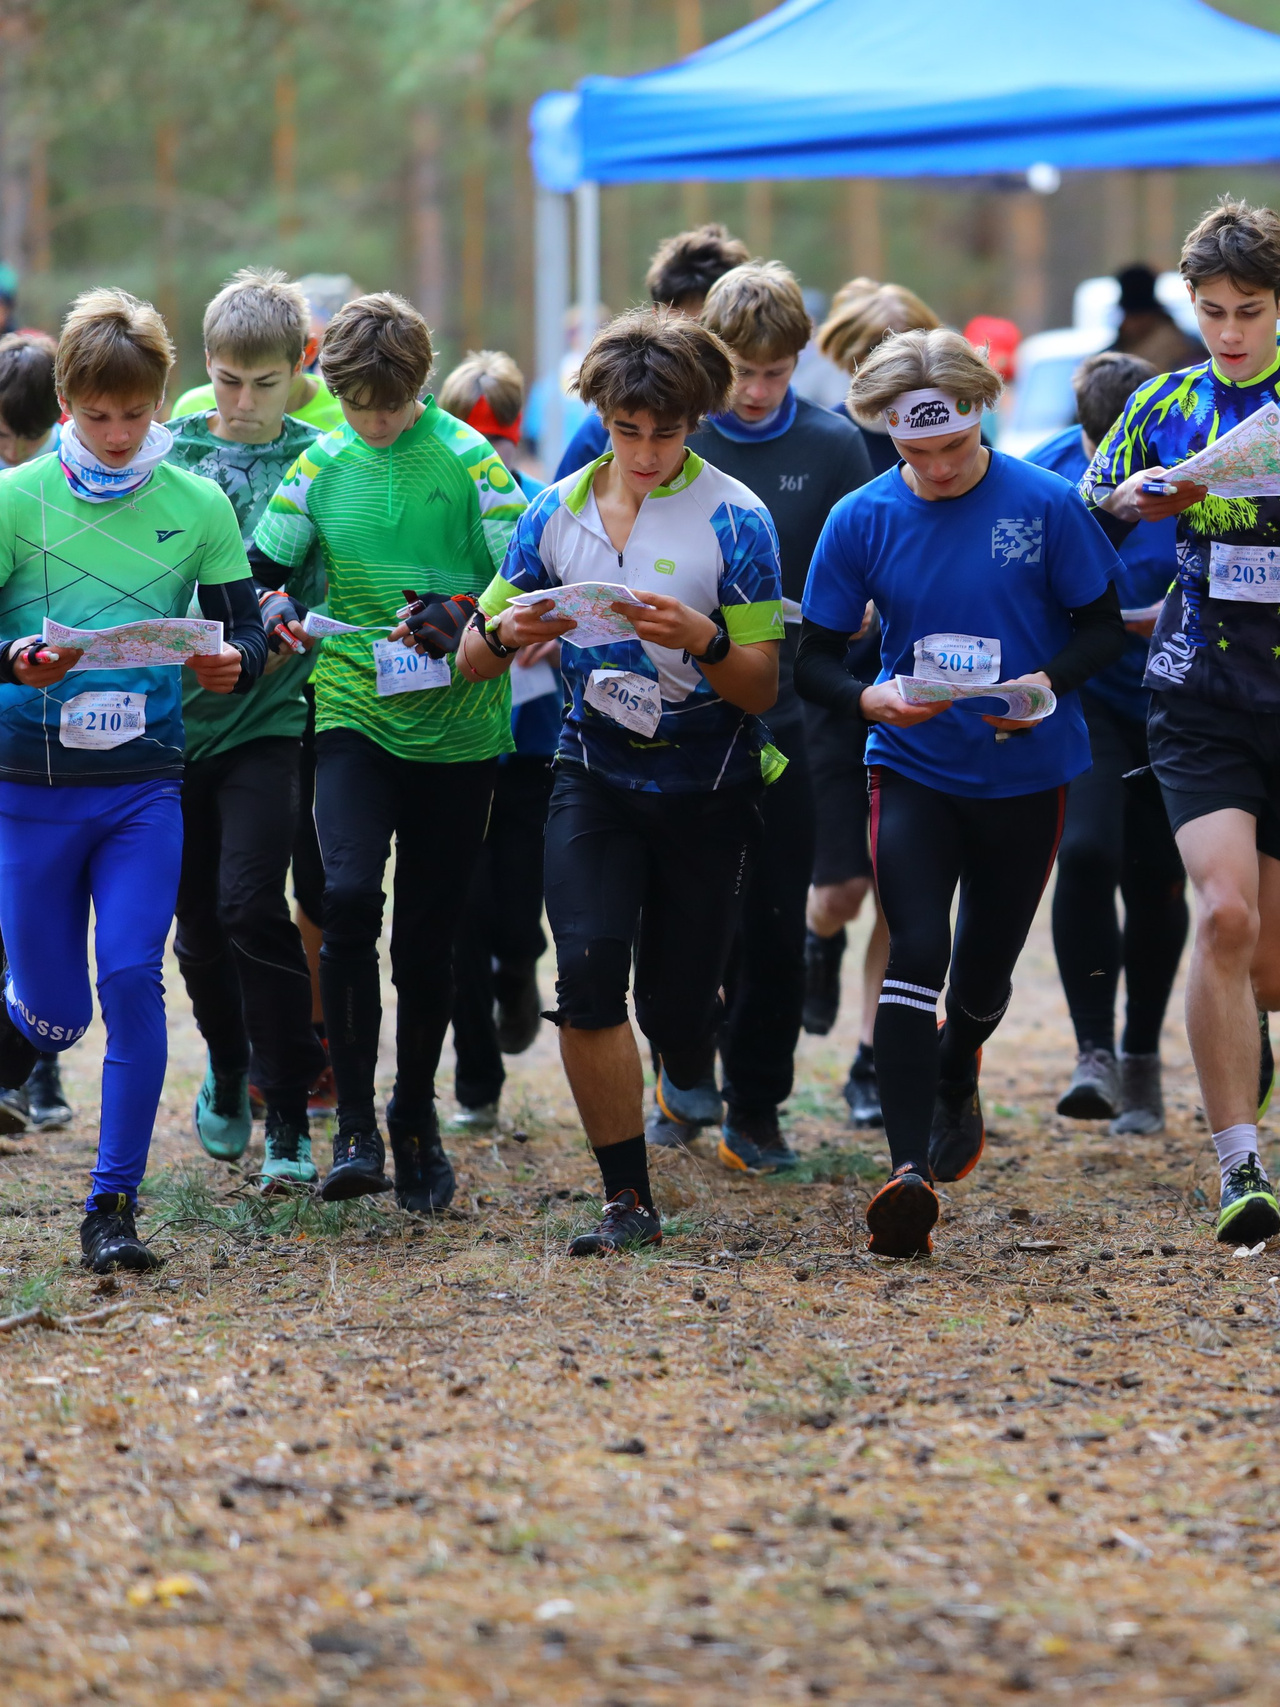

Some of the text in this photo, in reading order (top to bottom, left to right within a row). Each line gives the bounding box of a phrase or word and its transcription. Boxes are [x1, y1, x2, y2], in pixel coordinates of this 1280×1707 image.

[910, 415, 950, 428] ZAURALOM
[1231, 564, 1267, 584] 203
[394, 653, 428, 675] 207
[937, 652, 974, 672] 204
[607, 682, 641, 711] 205
[85, 711, 122, 731] 210
[17, 999, 85, 1041] RUSSIA
